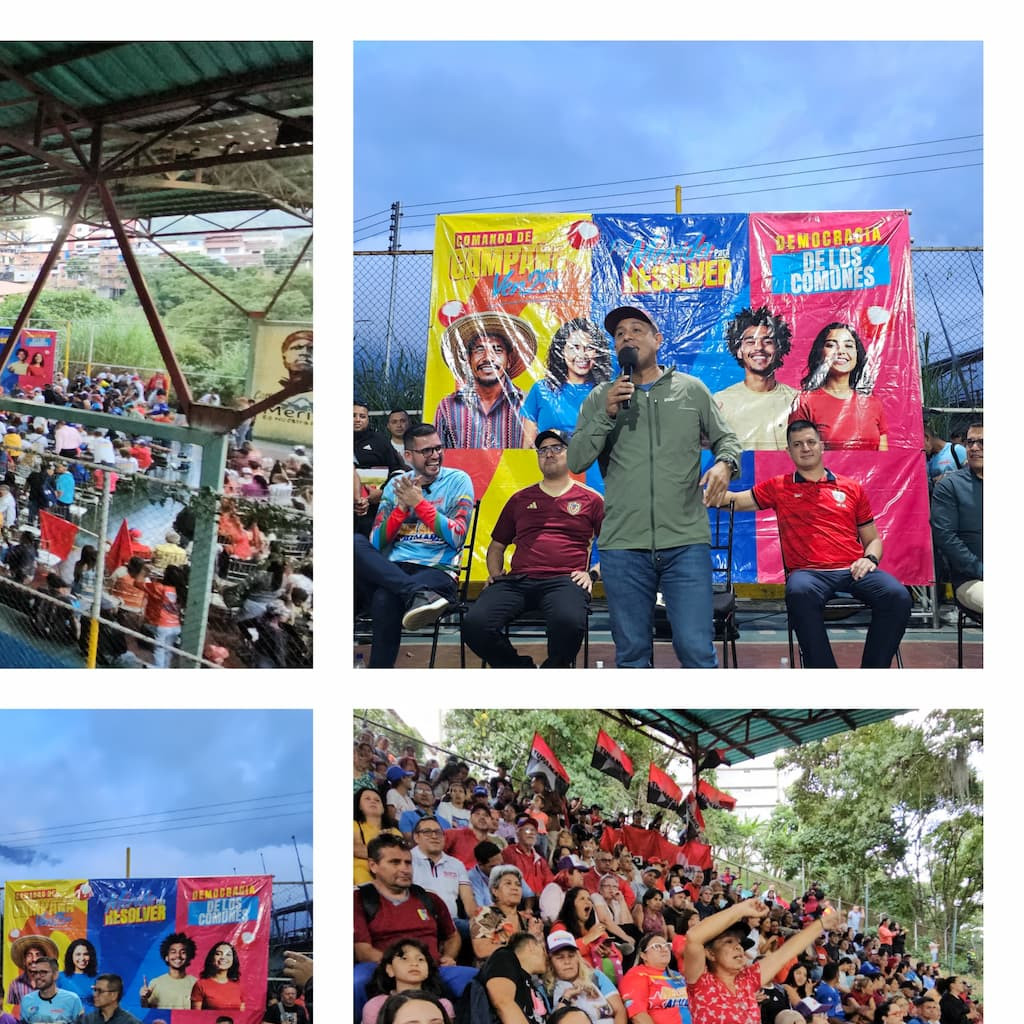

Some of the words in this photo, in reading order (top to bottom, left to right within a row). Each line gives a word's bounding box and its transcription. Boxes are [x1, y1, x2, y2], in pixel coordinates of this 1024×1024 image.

[455, 233, 514, 249] COMANDO
[516, 230, 533, 246] DE
[777, 227, 882, 250] DEMOCRACIA
[803, 250, 825, 271] DE
[829, 247, 862, 269] LOS
[790, 266, 875, 294] COMUNES
[104, 904, 167, 926] RESOLVER
